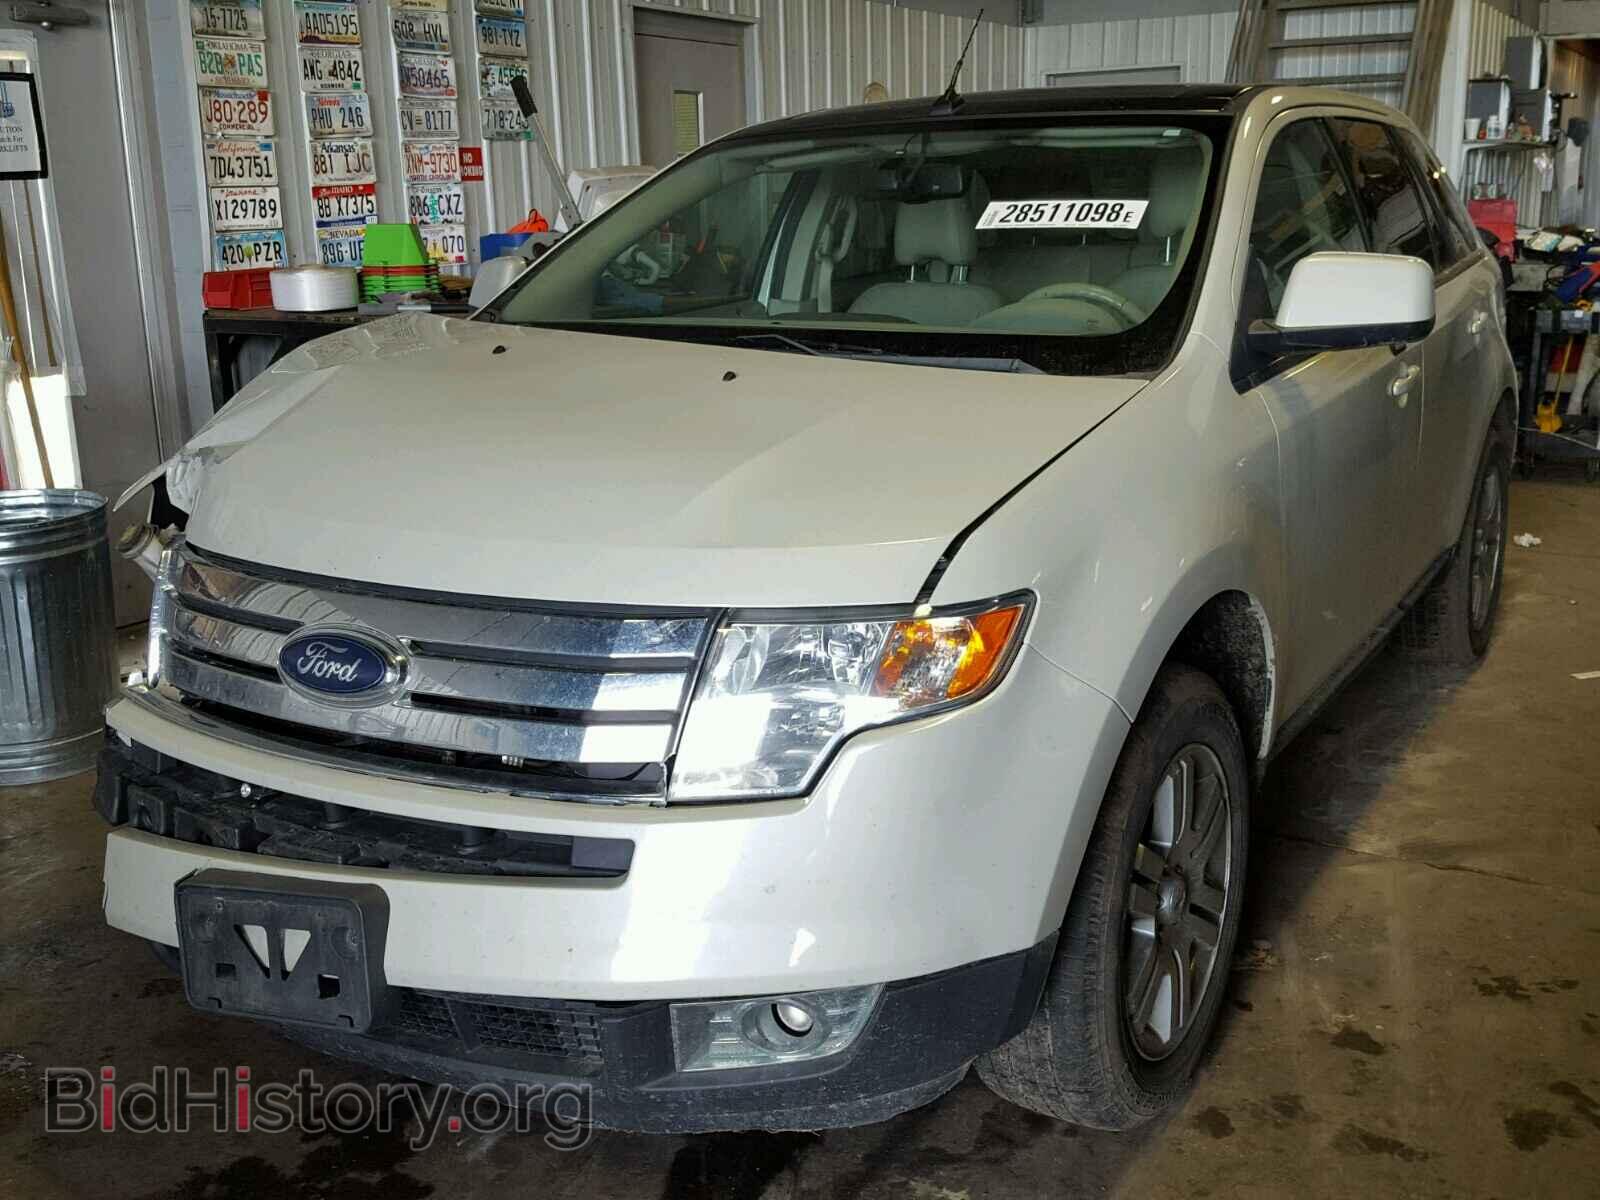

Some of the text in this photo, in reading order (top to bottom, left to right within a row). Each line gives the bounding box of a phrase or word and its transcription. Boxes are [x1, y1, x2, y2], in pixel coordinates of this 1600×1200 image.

[339, 106, 364, 128] 246
[214, 198, 276, 220] X129789
[438, 193, 463, 215] CXZ
[999, 203, 1124, 222] 28511098
[1123, 211, 1134, 222] E
[222, 241, 282, 264] 420 PZR
[297, 641, 362, 682] Ford
